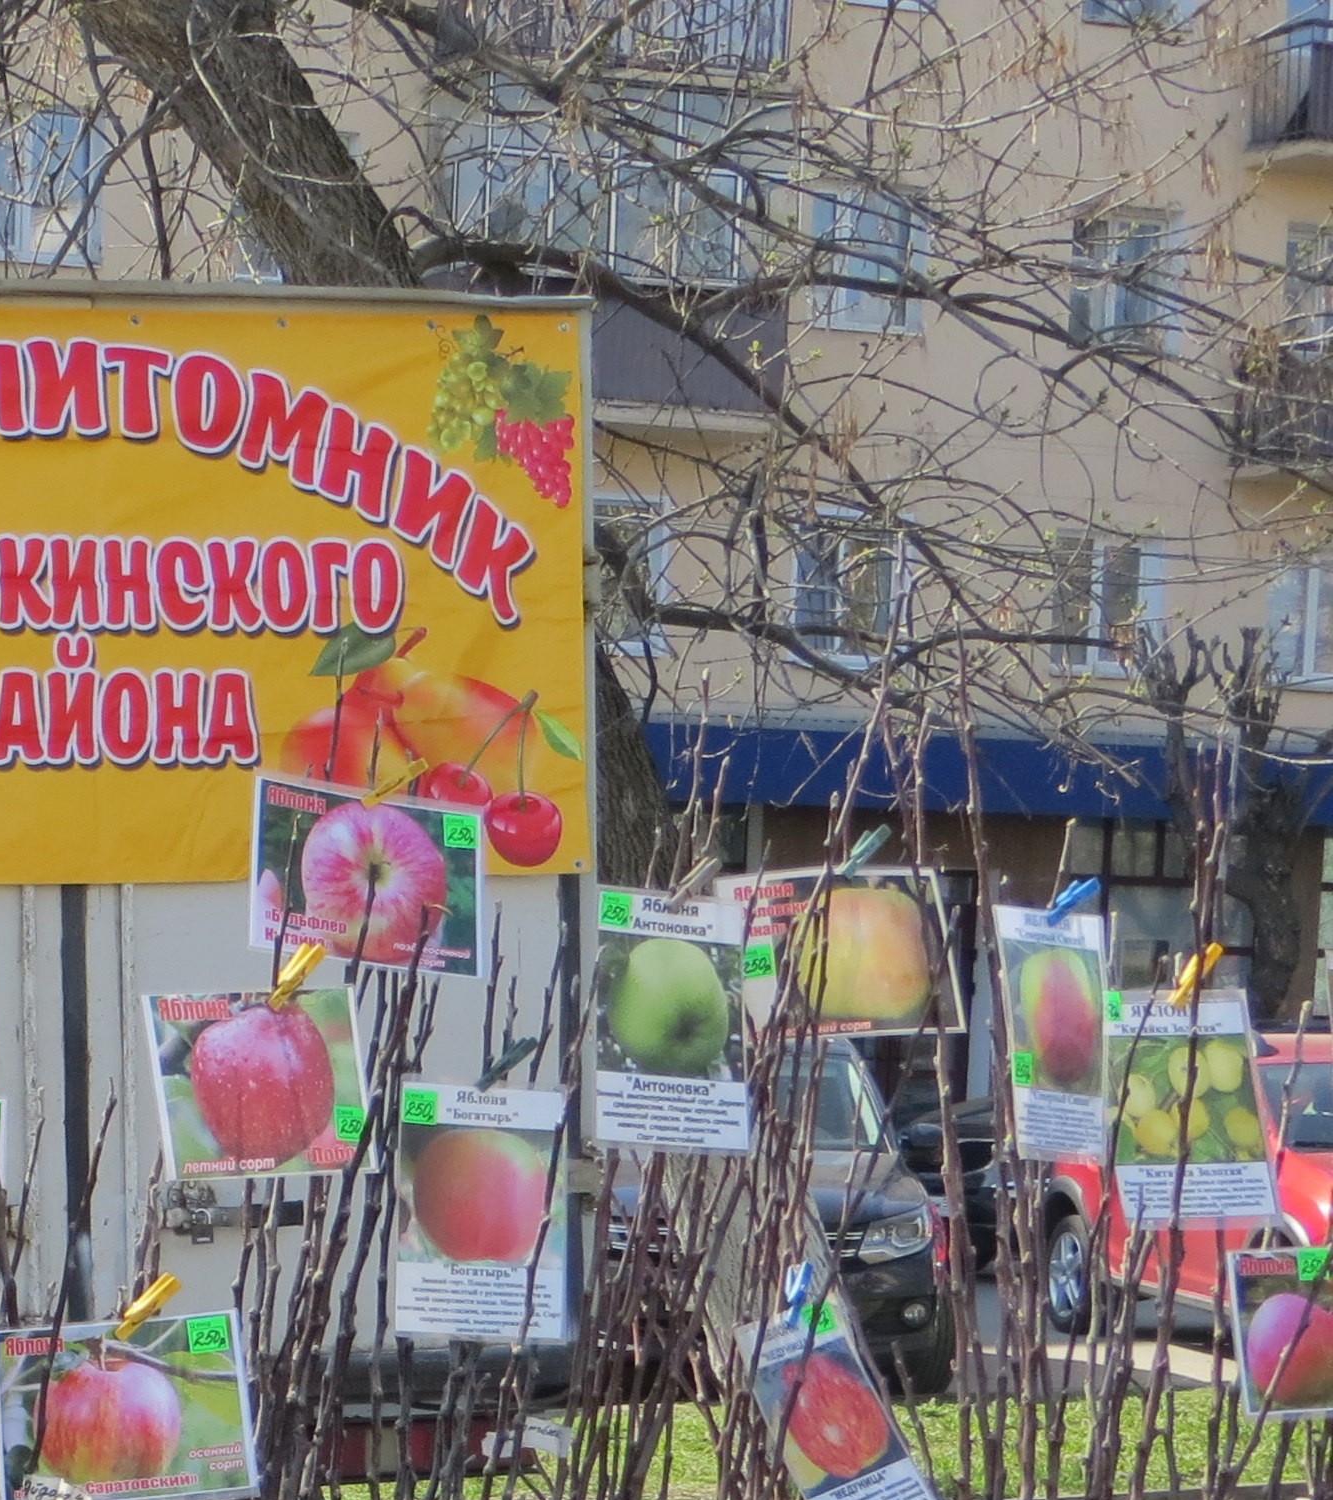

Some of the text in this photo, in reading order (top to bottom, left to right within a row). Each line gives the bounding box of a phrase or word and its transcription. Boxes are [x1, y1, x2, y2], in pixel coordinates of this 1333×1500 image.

[267, 785, 327, 815] Яблоня
[265, 908, 347, 934] «Бльфлер
[157, 998, 230, 1022] Яблоня
[840, 1020, 872, 1033] сорт
[625, 1075, 717, 1096] "Антоновка"
[455, 1090, 508, 1106] Яблоня
[445, 1107, 519, 1125] "Богатырь"
[183, 1157, 275, 1174] летний сорт
[443, 1263, 518, 1280] "Богатырь"
[188, 1443, 242, 1460] осенний
[209, 1458, 243, 1472] сорт
[85, 1472, 199, 1495] Саратовский»
